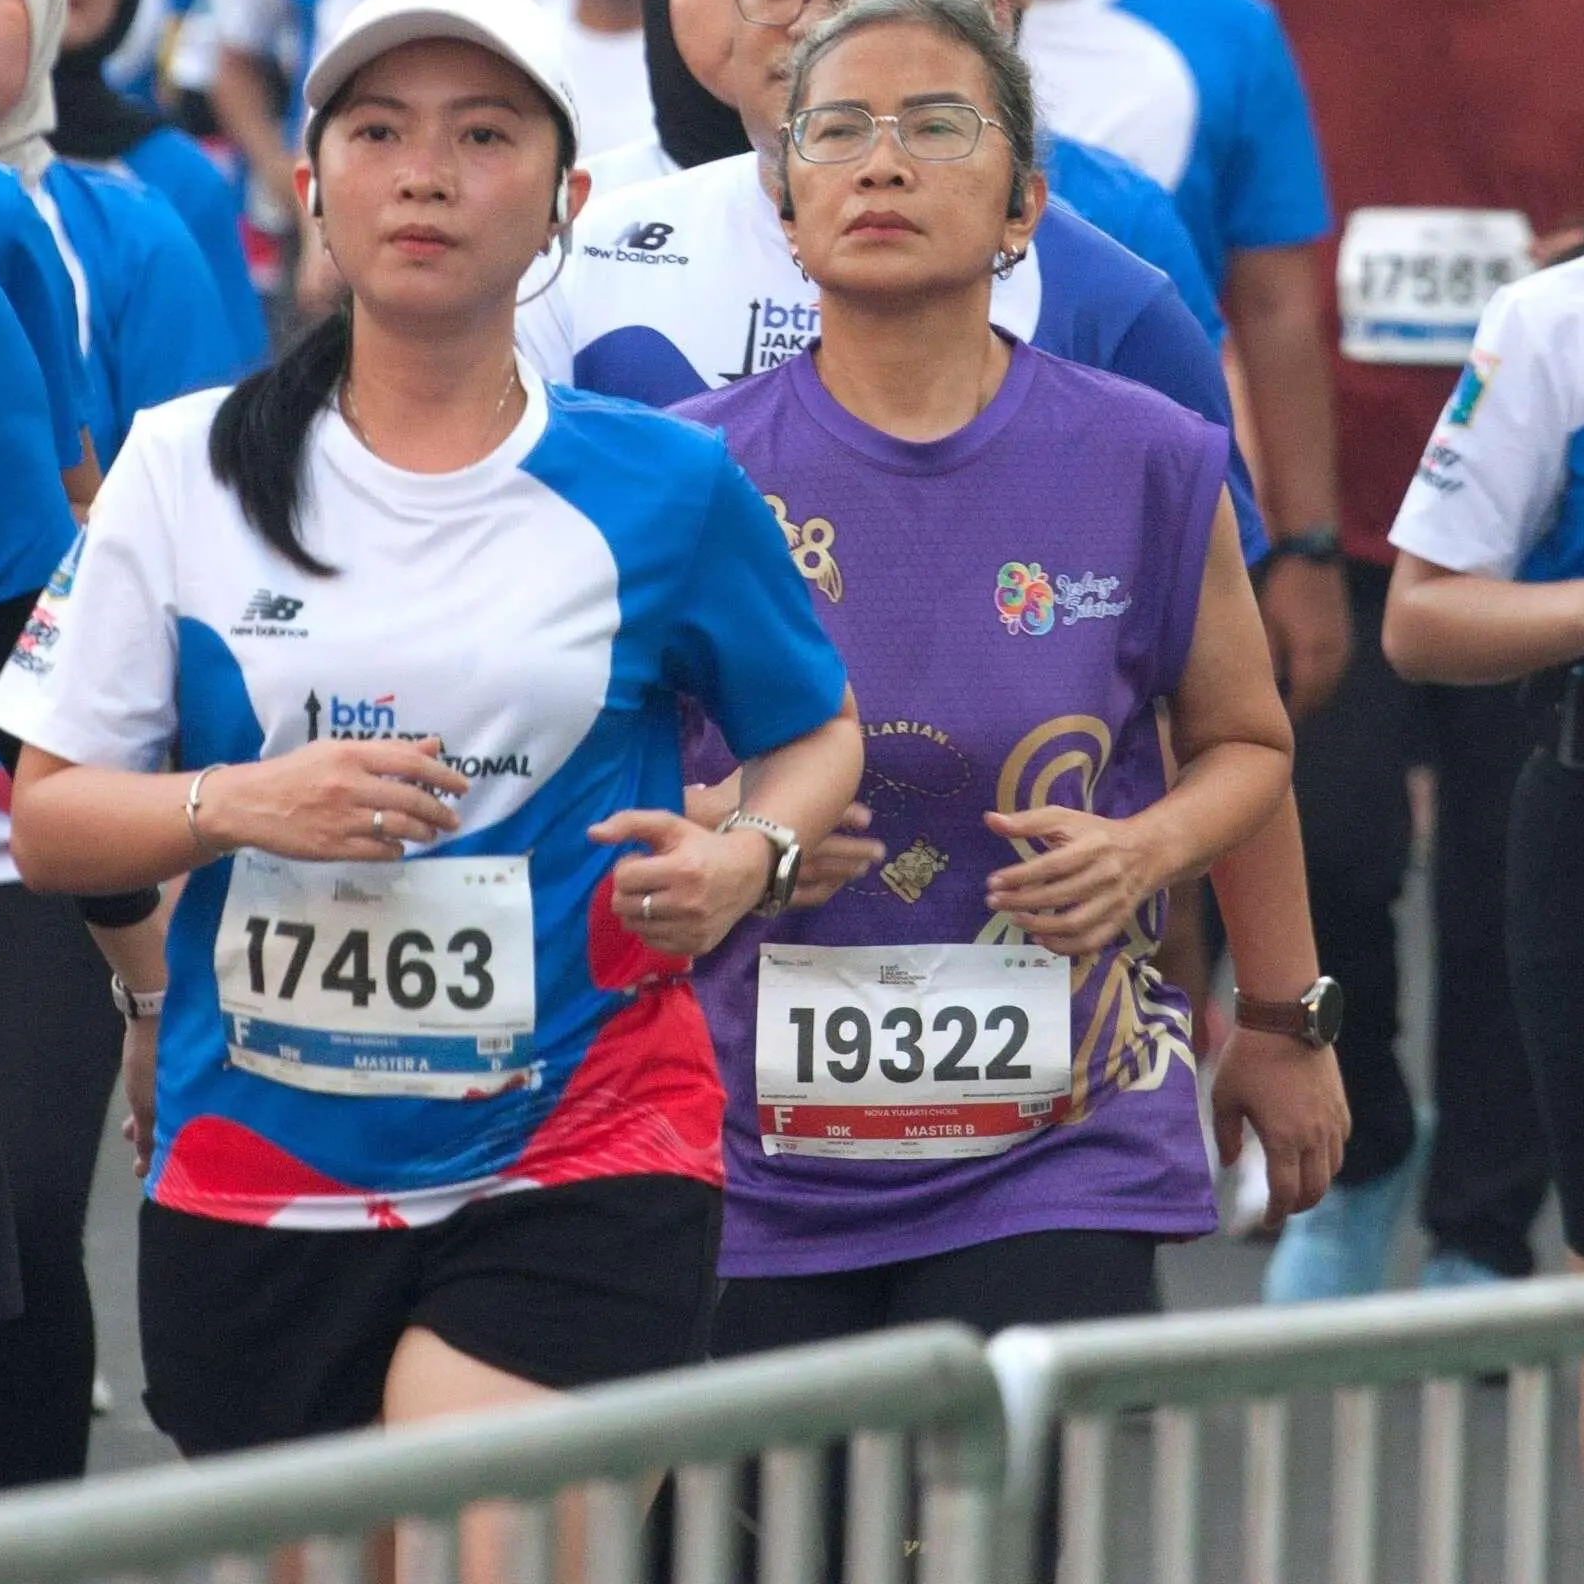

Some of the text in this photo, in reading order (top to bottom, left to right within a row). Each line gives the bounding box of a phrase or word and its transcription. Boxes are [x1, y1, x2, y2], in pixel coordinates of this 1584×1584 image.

[616, 246, 689, 265] balance
[331, 694, 395, 728] btn
[245, 915, 494, 1010] 17463
[234, 1016, 250, 1045] F
[789, 1005, 1032, 1084] 19322
[353, 1056, 415, 1072] MASTER
[417, 1056, 429, 1072] A
[774, 1106, 794, 1133] F
[864, 1109, 889, 1117] NOVA
[825, 1125, 852, 1137] 10K
[905, 1125, 962, 1137] MASTER
[965, 1124, 975, 1135] B
